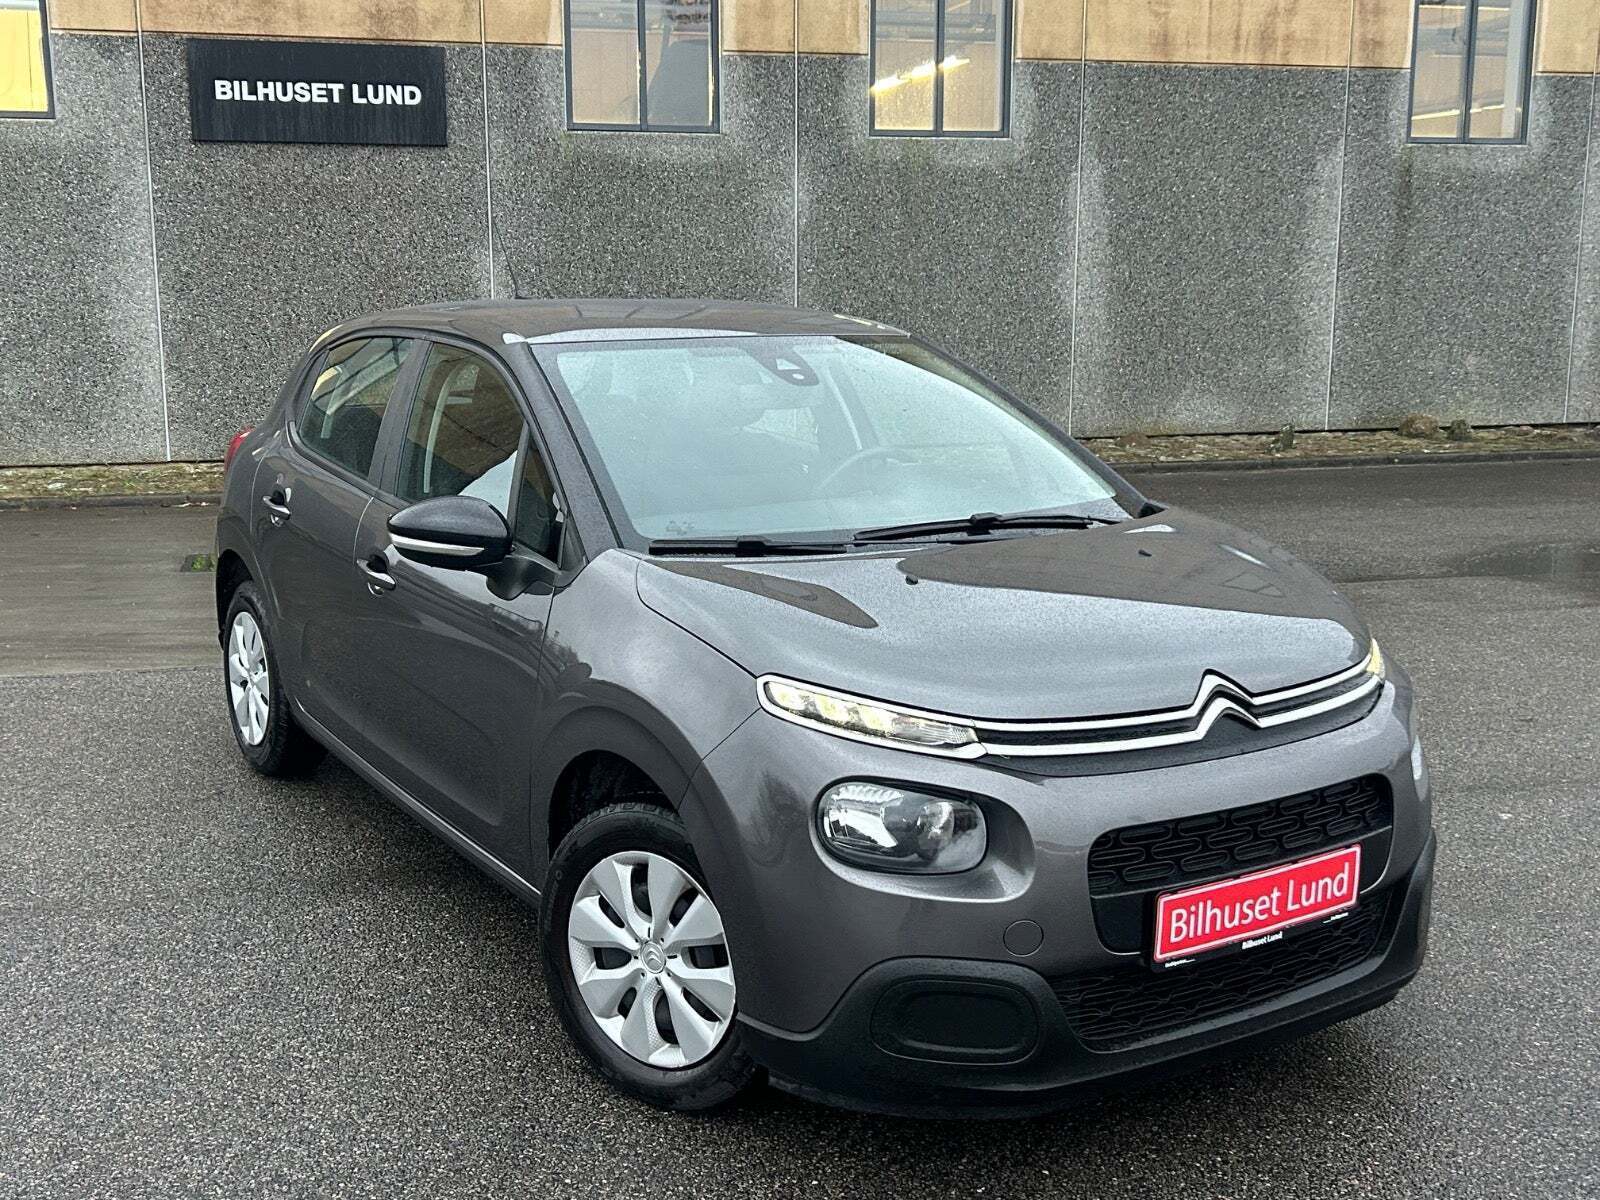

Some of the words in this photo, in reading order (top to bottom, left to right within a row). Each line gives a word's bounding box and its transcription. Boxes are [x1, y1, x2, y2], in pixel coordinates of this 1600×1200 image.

[214, 79, 344, 104] BILHUSET
[352, 83, 422, 106] LUND
[1169, 886, 1281, 944] Bilhuset
[1286, 861, 1349, 912] Lund
